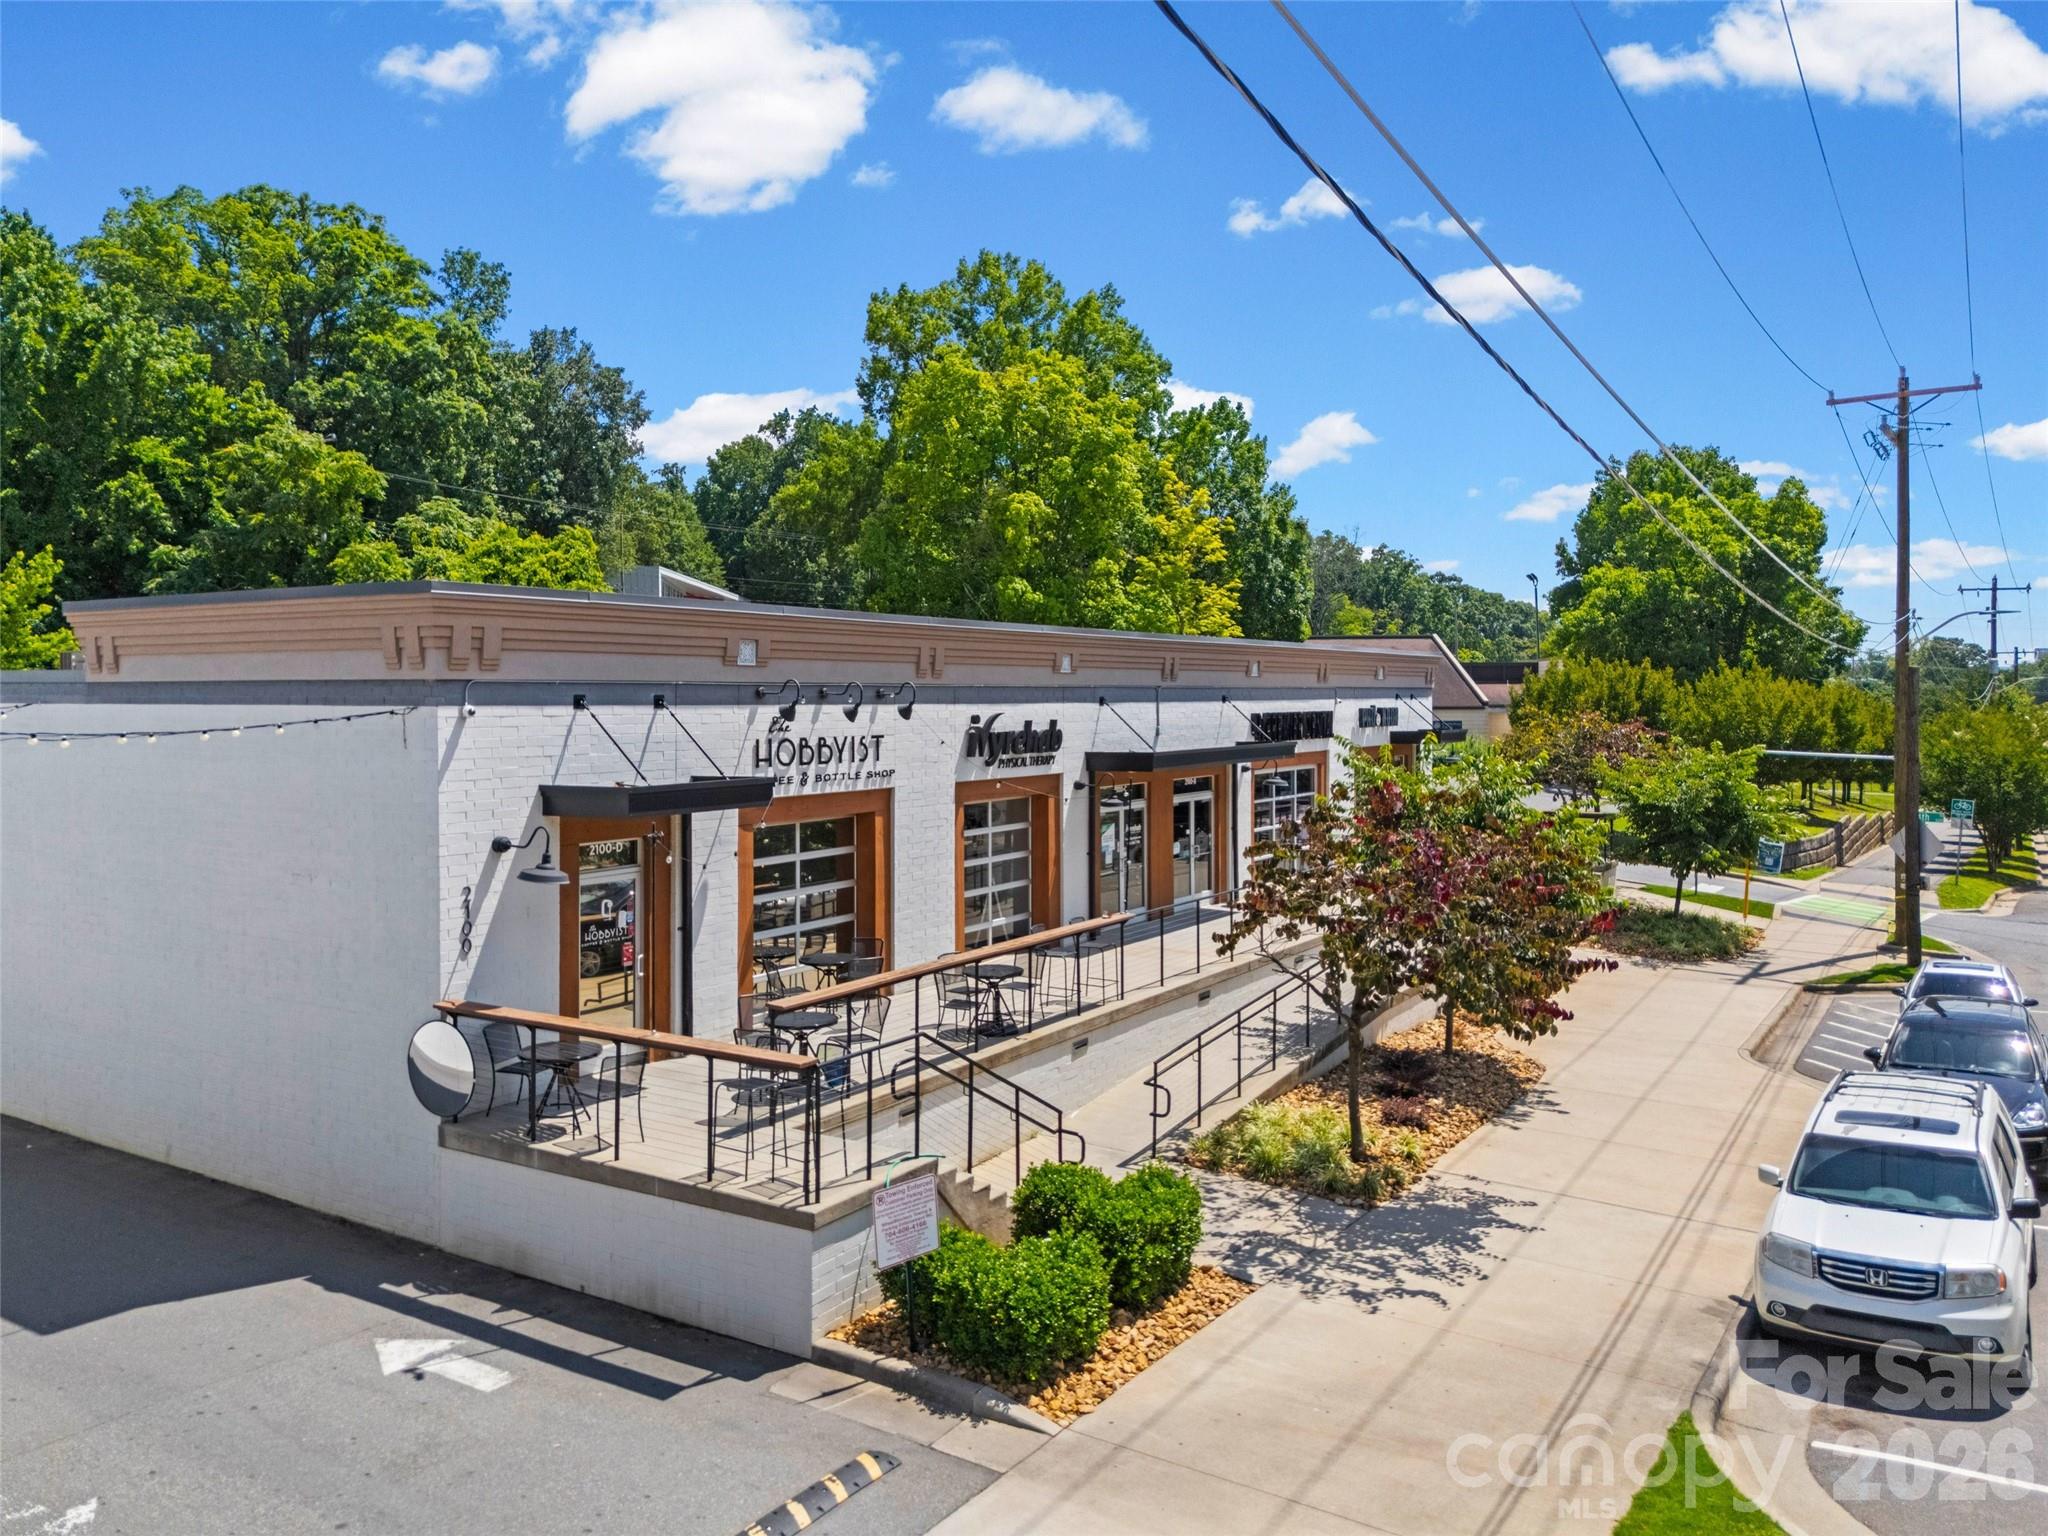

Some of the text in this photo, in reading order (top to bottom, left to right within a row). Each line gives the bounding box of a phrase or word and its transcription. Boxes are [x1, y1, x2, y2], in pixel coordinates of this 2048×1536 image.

[755, 735, 885, 768] HOBBYIST
[800, 772, 810, 787] &
[815, 771, 862, 783] BOTTLE
[866, 769, 896, 779] SHOP
[590, 842, 623, 856] 2100-D
[885, 1179, 933, 1199] Towing Enforced
